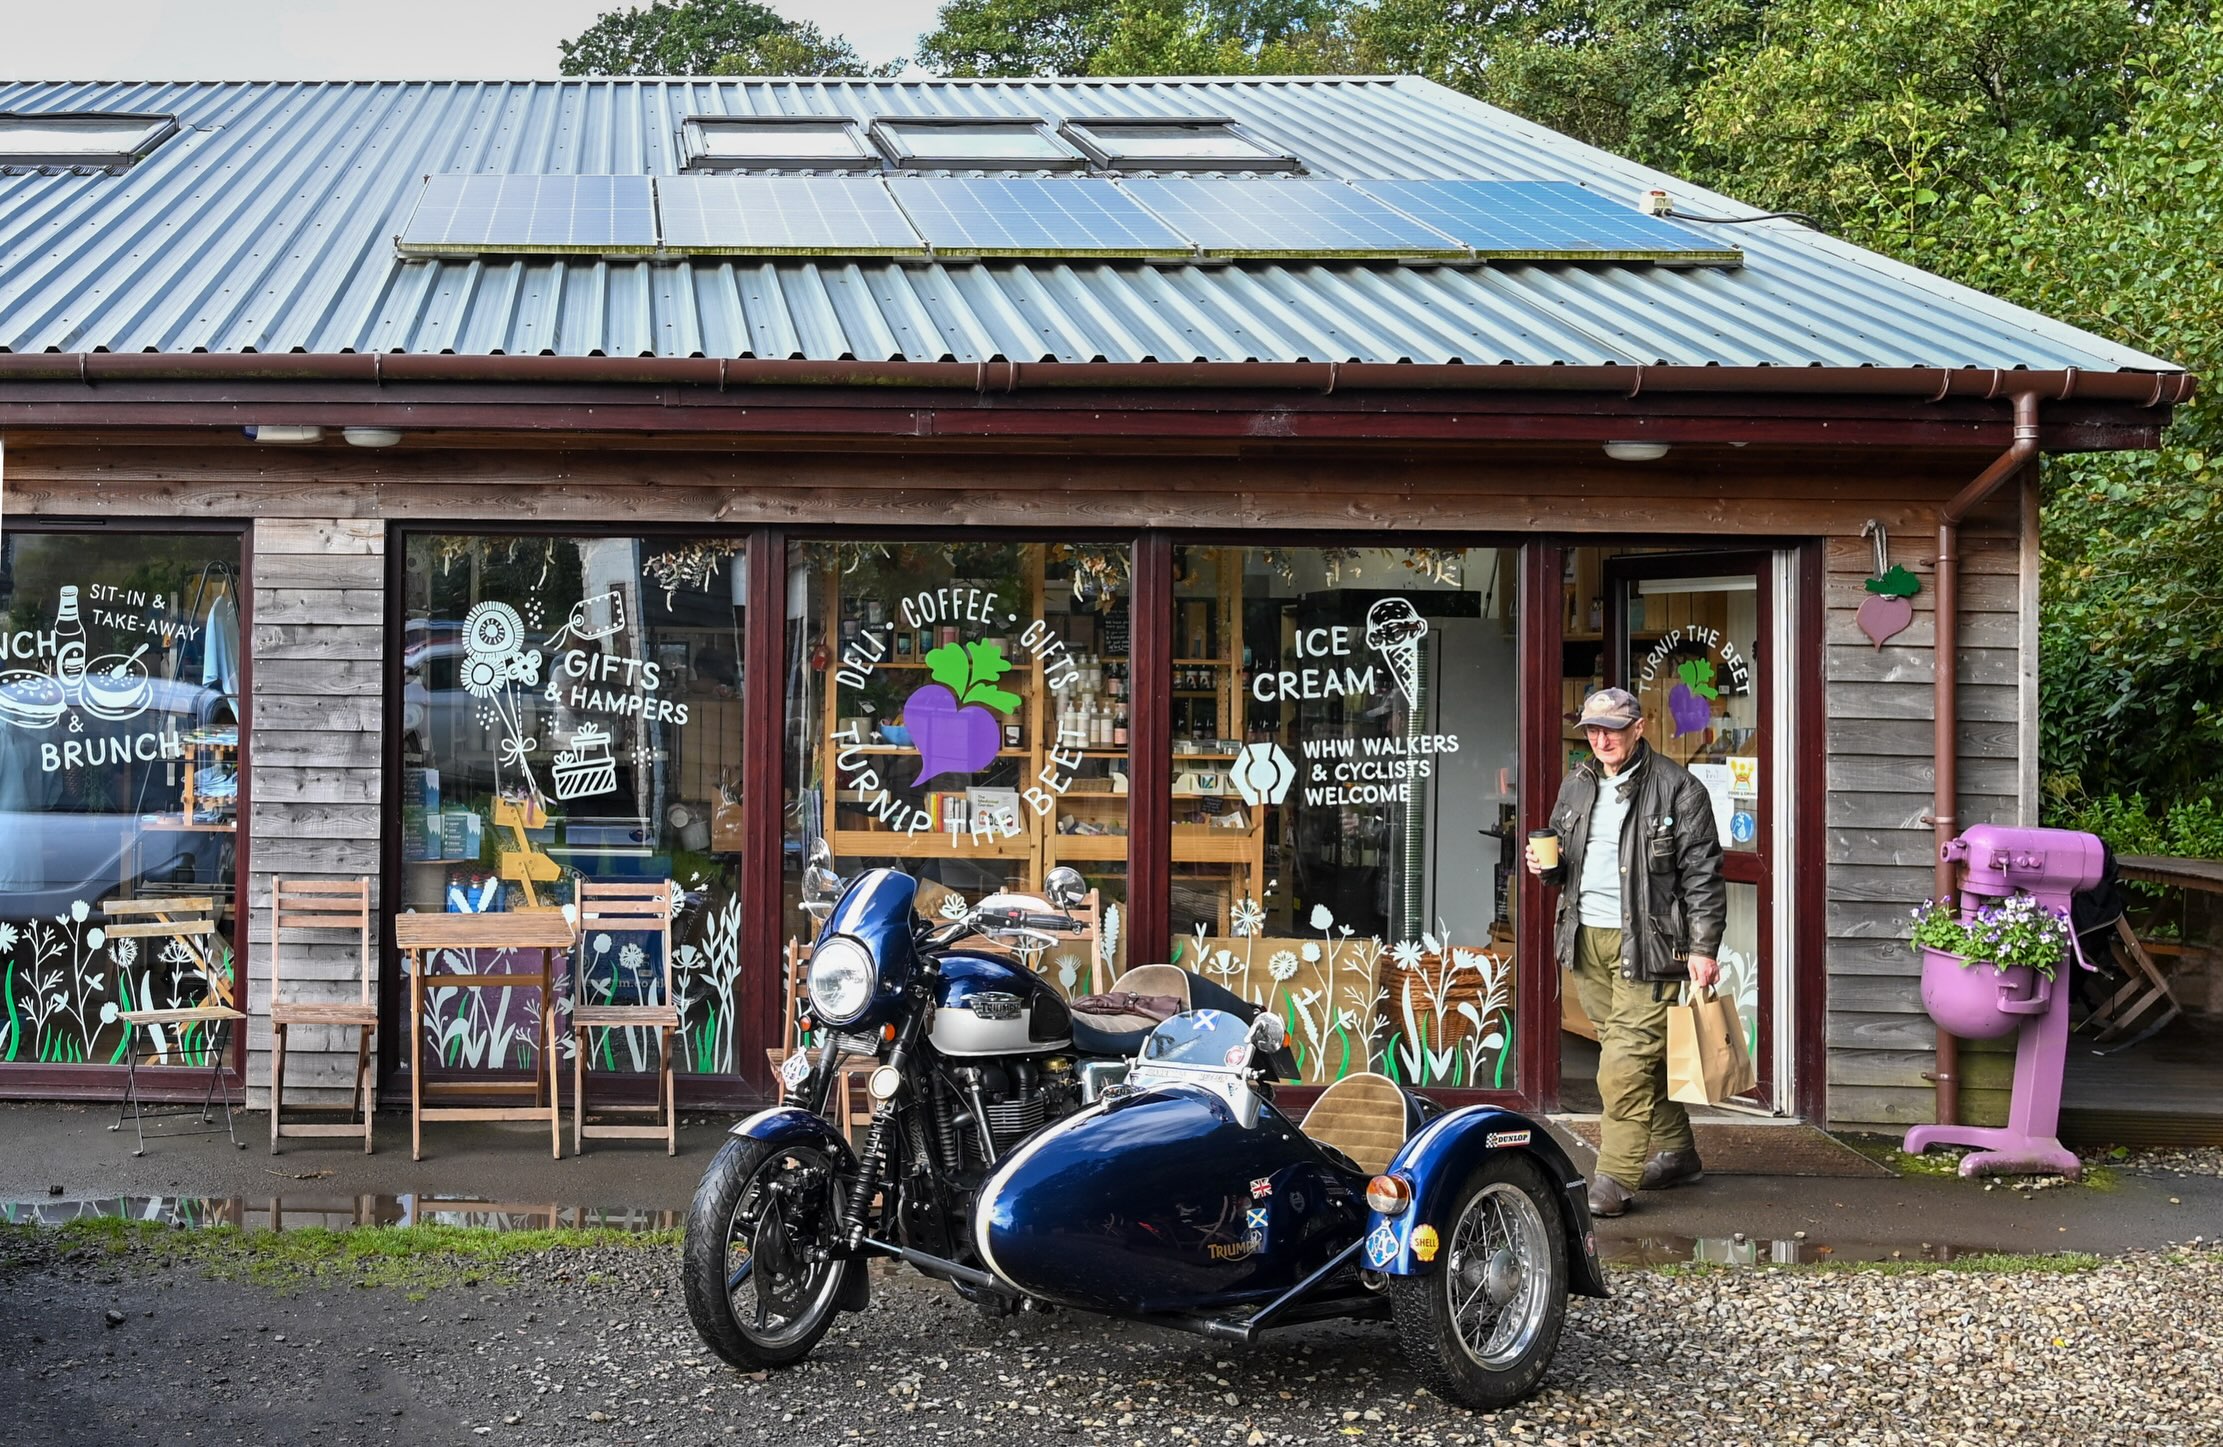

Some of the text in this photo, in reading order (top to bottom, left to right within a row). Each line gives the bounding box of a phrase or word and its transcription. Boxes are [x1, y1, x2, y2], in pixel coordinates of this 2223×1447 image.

[89, 584, 165, 609] SIT-IN &
[92, 609, 199, 641] TAKE-AWAY
[835, 629, 886, 690] DELI
[902, 588, 998, 629] COFFEE
[1020, 619, 1079, 690] GIFTS
[1295, 626, 1350, 658] ICE
[564, 650, 661, 690] GIFTS
[1639, 625, 1750, 695] TURNIP THE BEET
[1252, 665, 1375, 701] CREAM
[544, 681, 689, 725] & HAMPERS
[68, 715, 84, 733] &
[41, 731, 182, 771] BRUNCH
[1303, 735, 1459, 759] WHW WALKERS
[830, 720, 1087, 848] TURNIP THE BEET
[1311, 760, 1431, 782] & CYCLISTS
[1305, 784, 1412, 807] WELCOME
[1498, 1134, 1528, 1143] DUNLOP
[1414, 1238, 1436, 1248] SHELL
